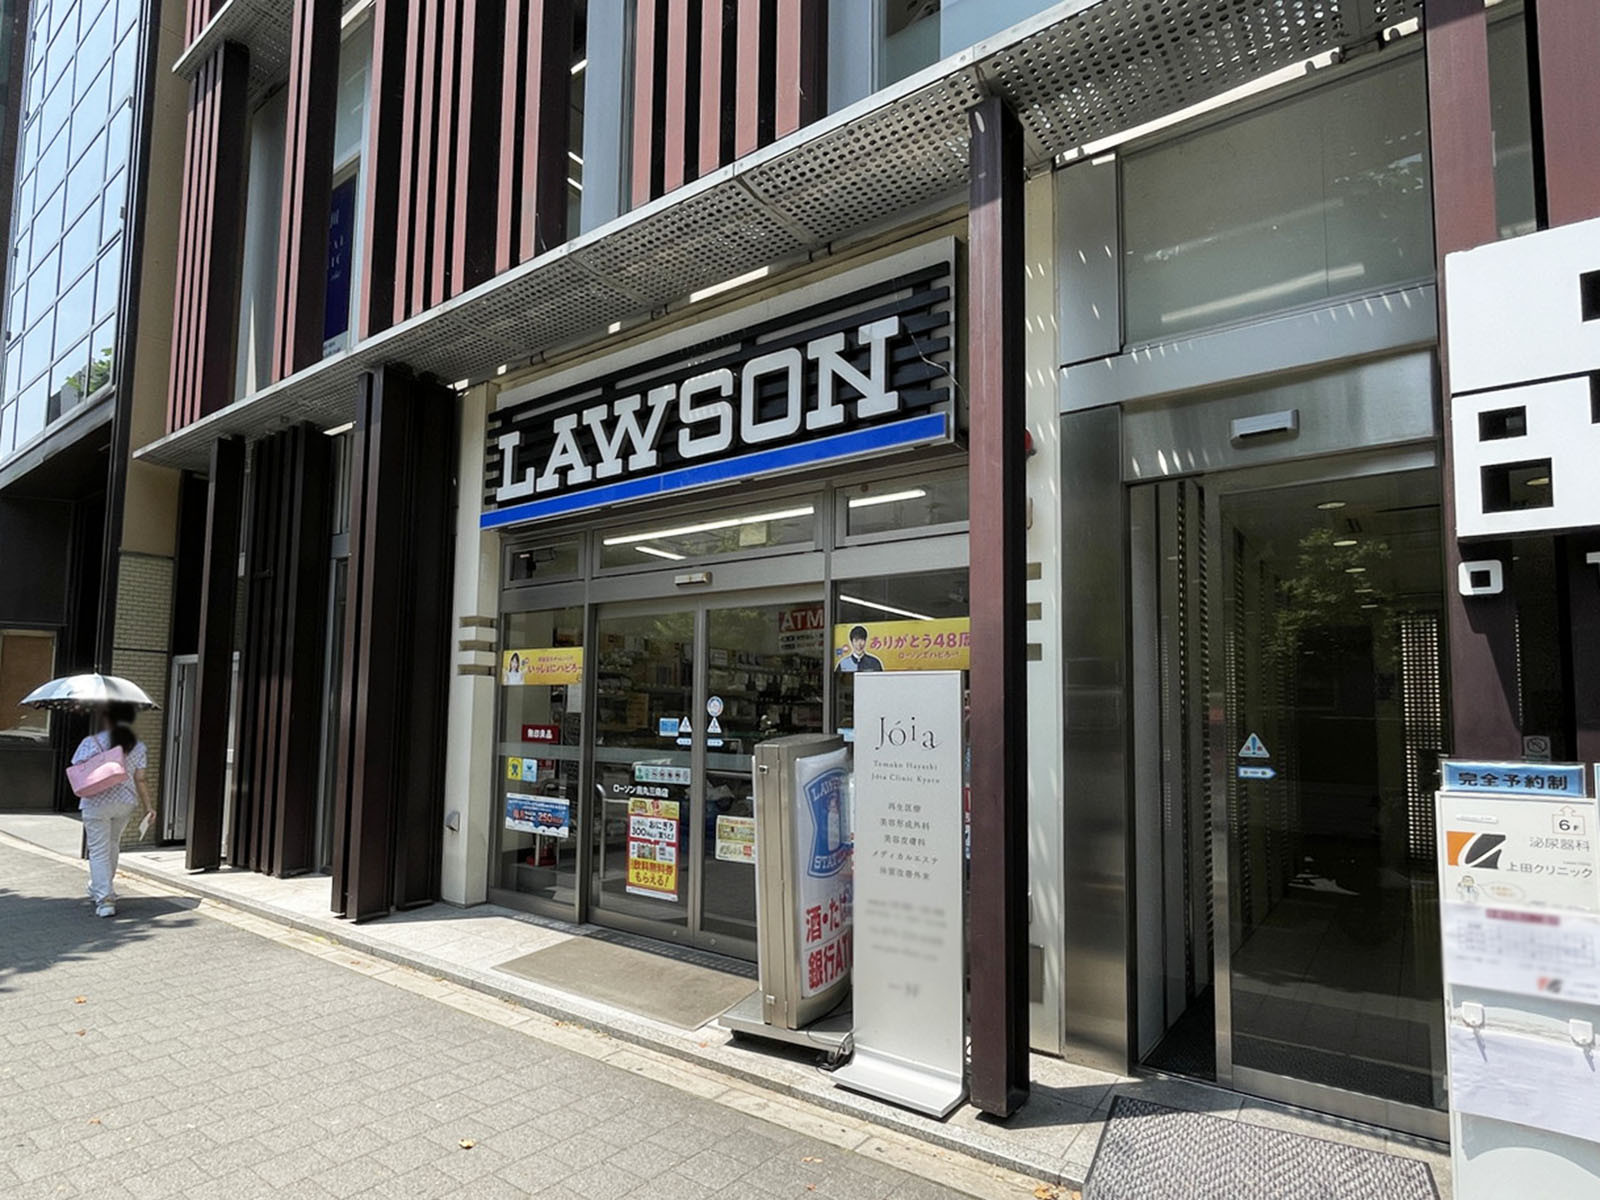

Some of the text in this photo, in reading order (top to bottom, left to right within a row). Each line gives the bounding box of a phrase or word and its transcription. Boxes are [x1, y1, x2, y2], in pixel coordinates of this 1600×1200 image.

[496, 315, 900, 502] LAWSON
[781, 609, 824, 632] ATM
[875, 717, 943, 750] Jóia
[1458, 772, 1568, 791] 完全予約制
[1558, 819, 1579, 832] 6F
[1529, 836, 1590, 852] 泌尿器科
[1506, 861, 1593, 879] 上田クリニック
